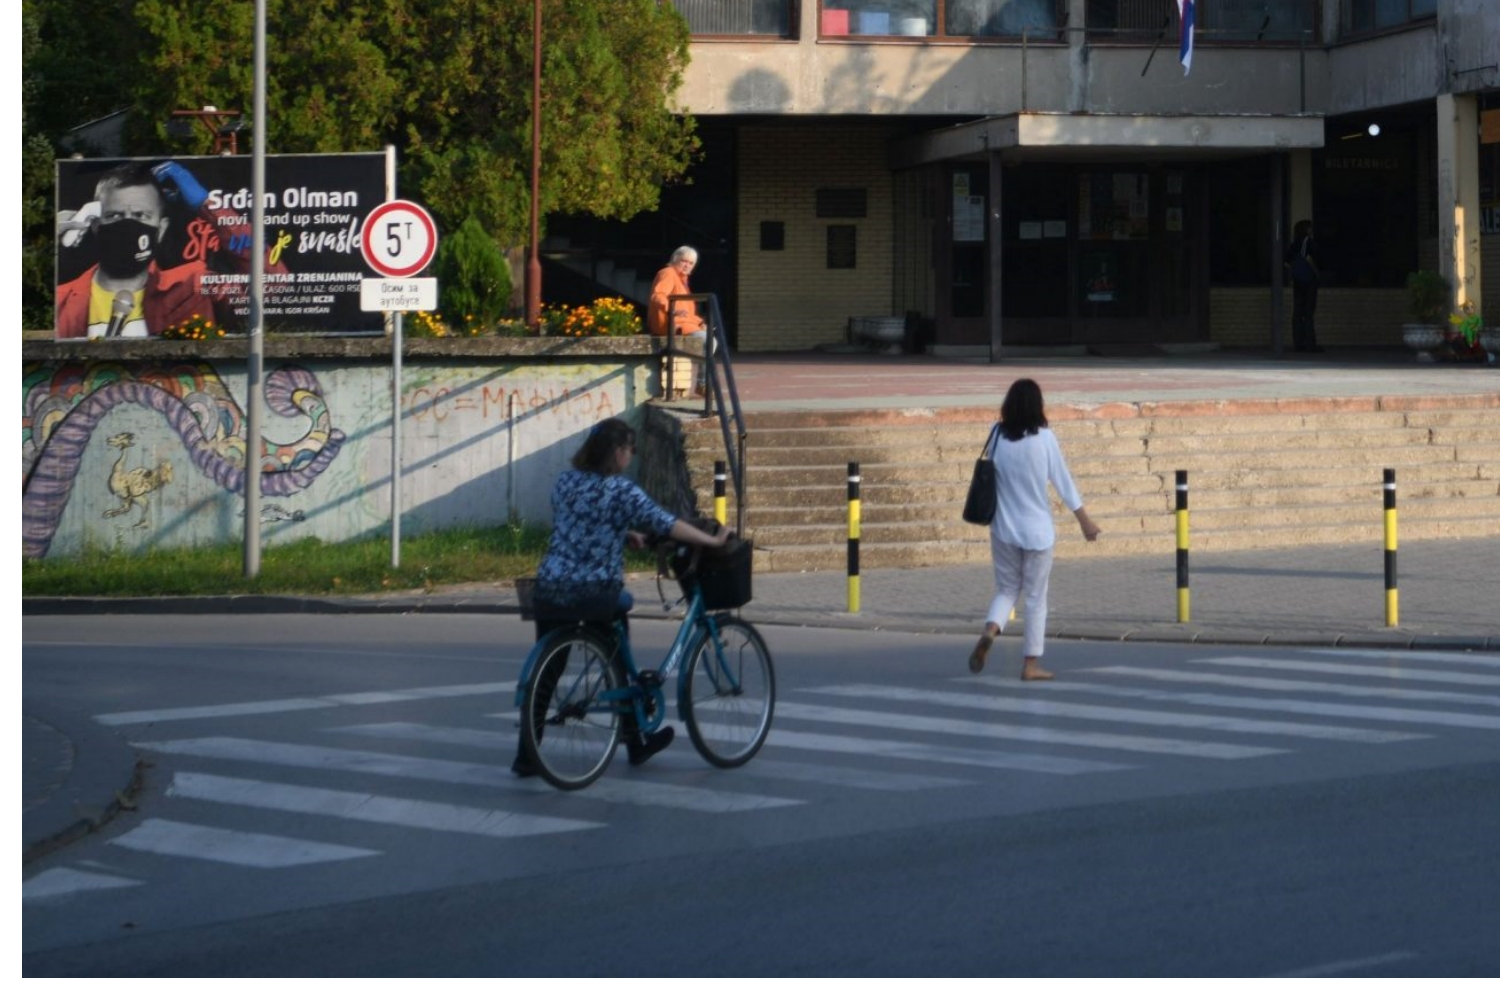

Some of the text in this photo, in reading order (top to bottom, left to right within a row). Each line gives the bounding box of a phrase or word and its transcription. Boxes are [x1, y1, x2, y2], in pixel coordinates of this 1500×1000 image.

[283, 187, 358, 208] Olman
[217, 212, 350, 228] novi and up show
[269, 230, 292, 265] je
[200, 272, 363, 285] KULTURN ENTAR ZRENJANINA
[328, 285, 345, 293] 600
[381, 282, 404, 293] Осим
[229, 296, 250, 305] KART
[380, 294, 420, 307] аутобусе
